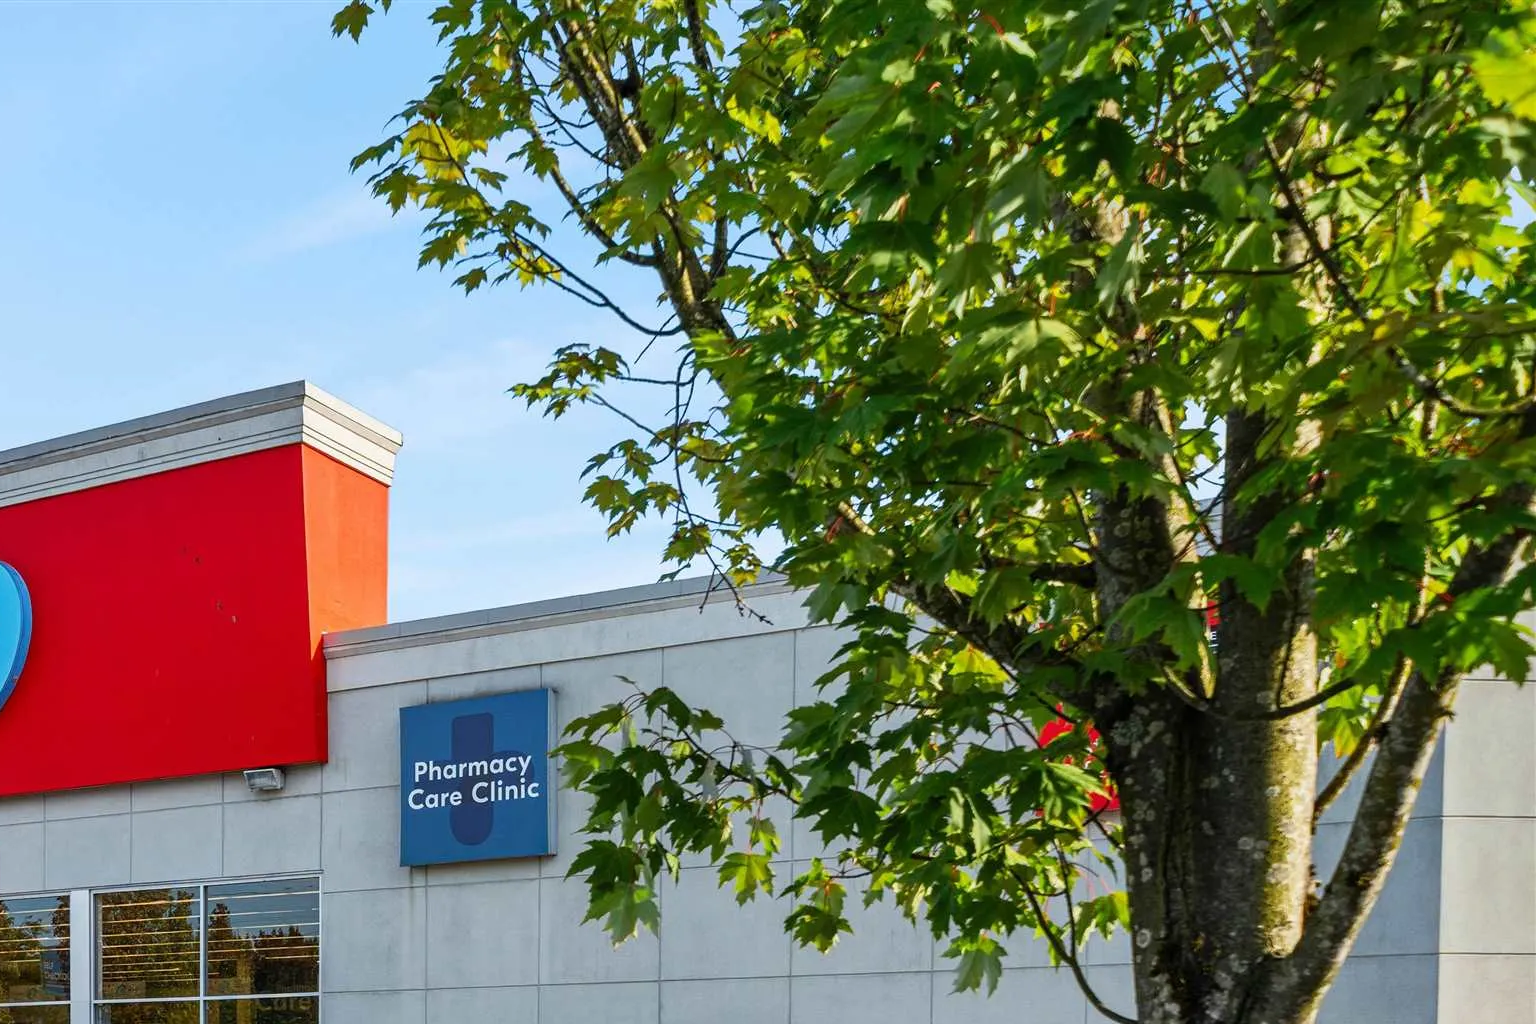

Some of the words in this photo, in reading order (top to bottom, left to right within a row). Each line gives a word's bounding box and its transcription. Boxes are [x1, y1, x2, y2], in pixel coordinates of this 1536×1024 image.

[414, 755, 532, 782] Pharmacy
[408, 789, 462, 810] Care
[471, 777, 540, 804] Clinic
